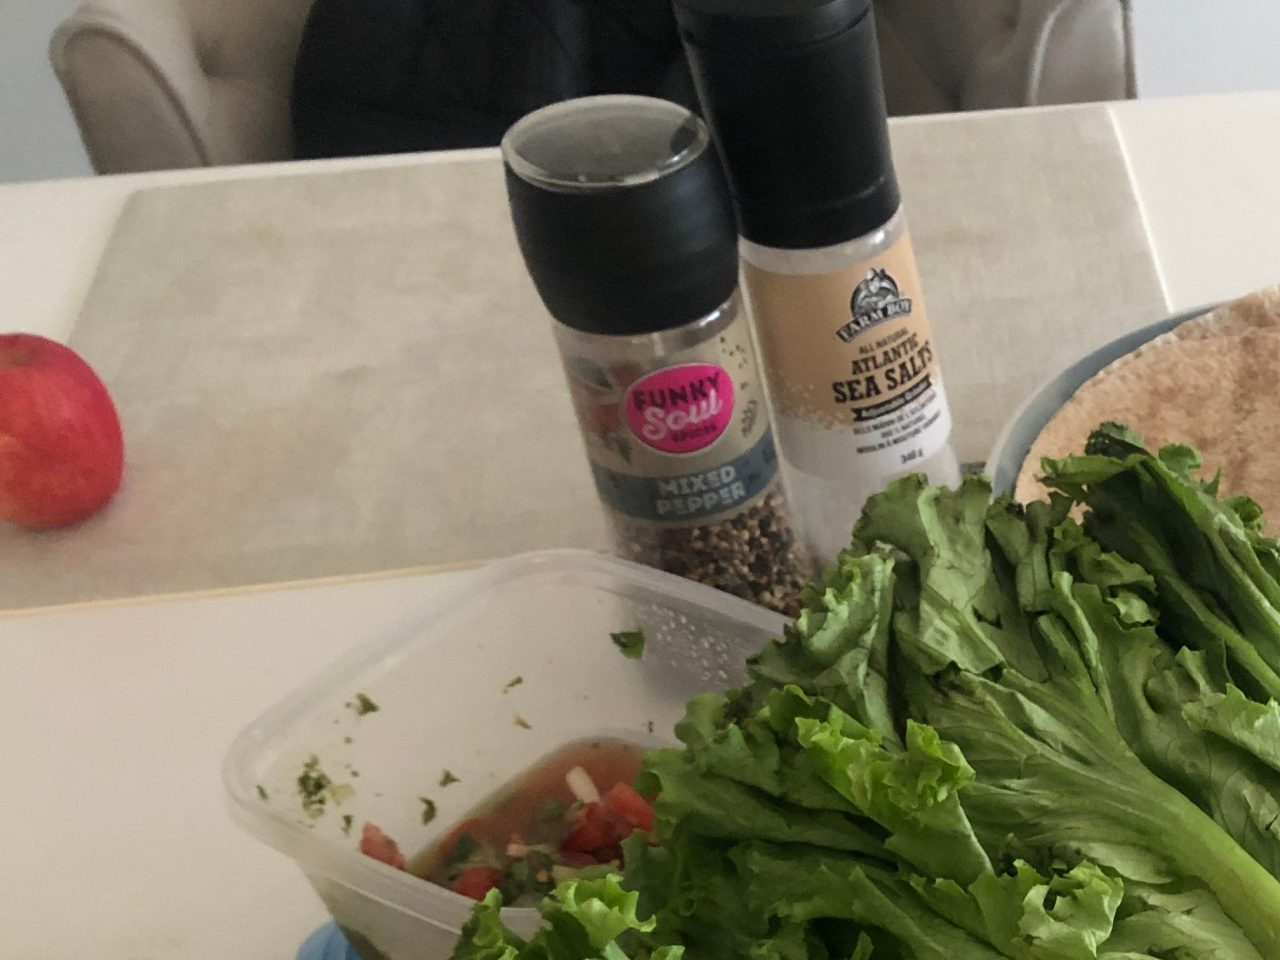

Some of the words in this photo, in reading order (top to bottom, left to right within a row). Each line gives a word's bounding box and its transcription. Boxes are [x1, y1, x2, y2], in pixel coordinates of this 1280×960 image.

[838, 309, 886, 340] FARM
[886, 300, 910, 316] BOY
[632, 372, 720, 411] FUNKY
[832, 375, 881, 404] SEA
[641, 388, 723, 440] Soul
[655, 480, 746, 514] PEPPER
[658, 465, 736, 496] MIXED
